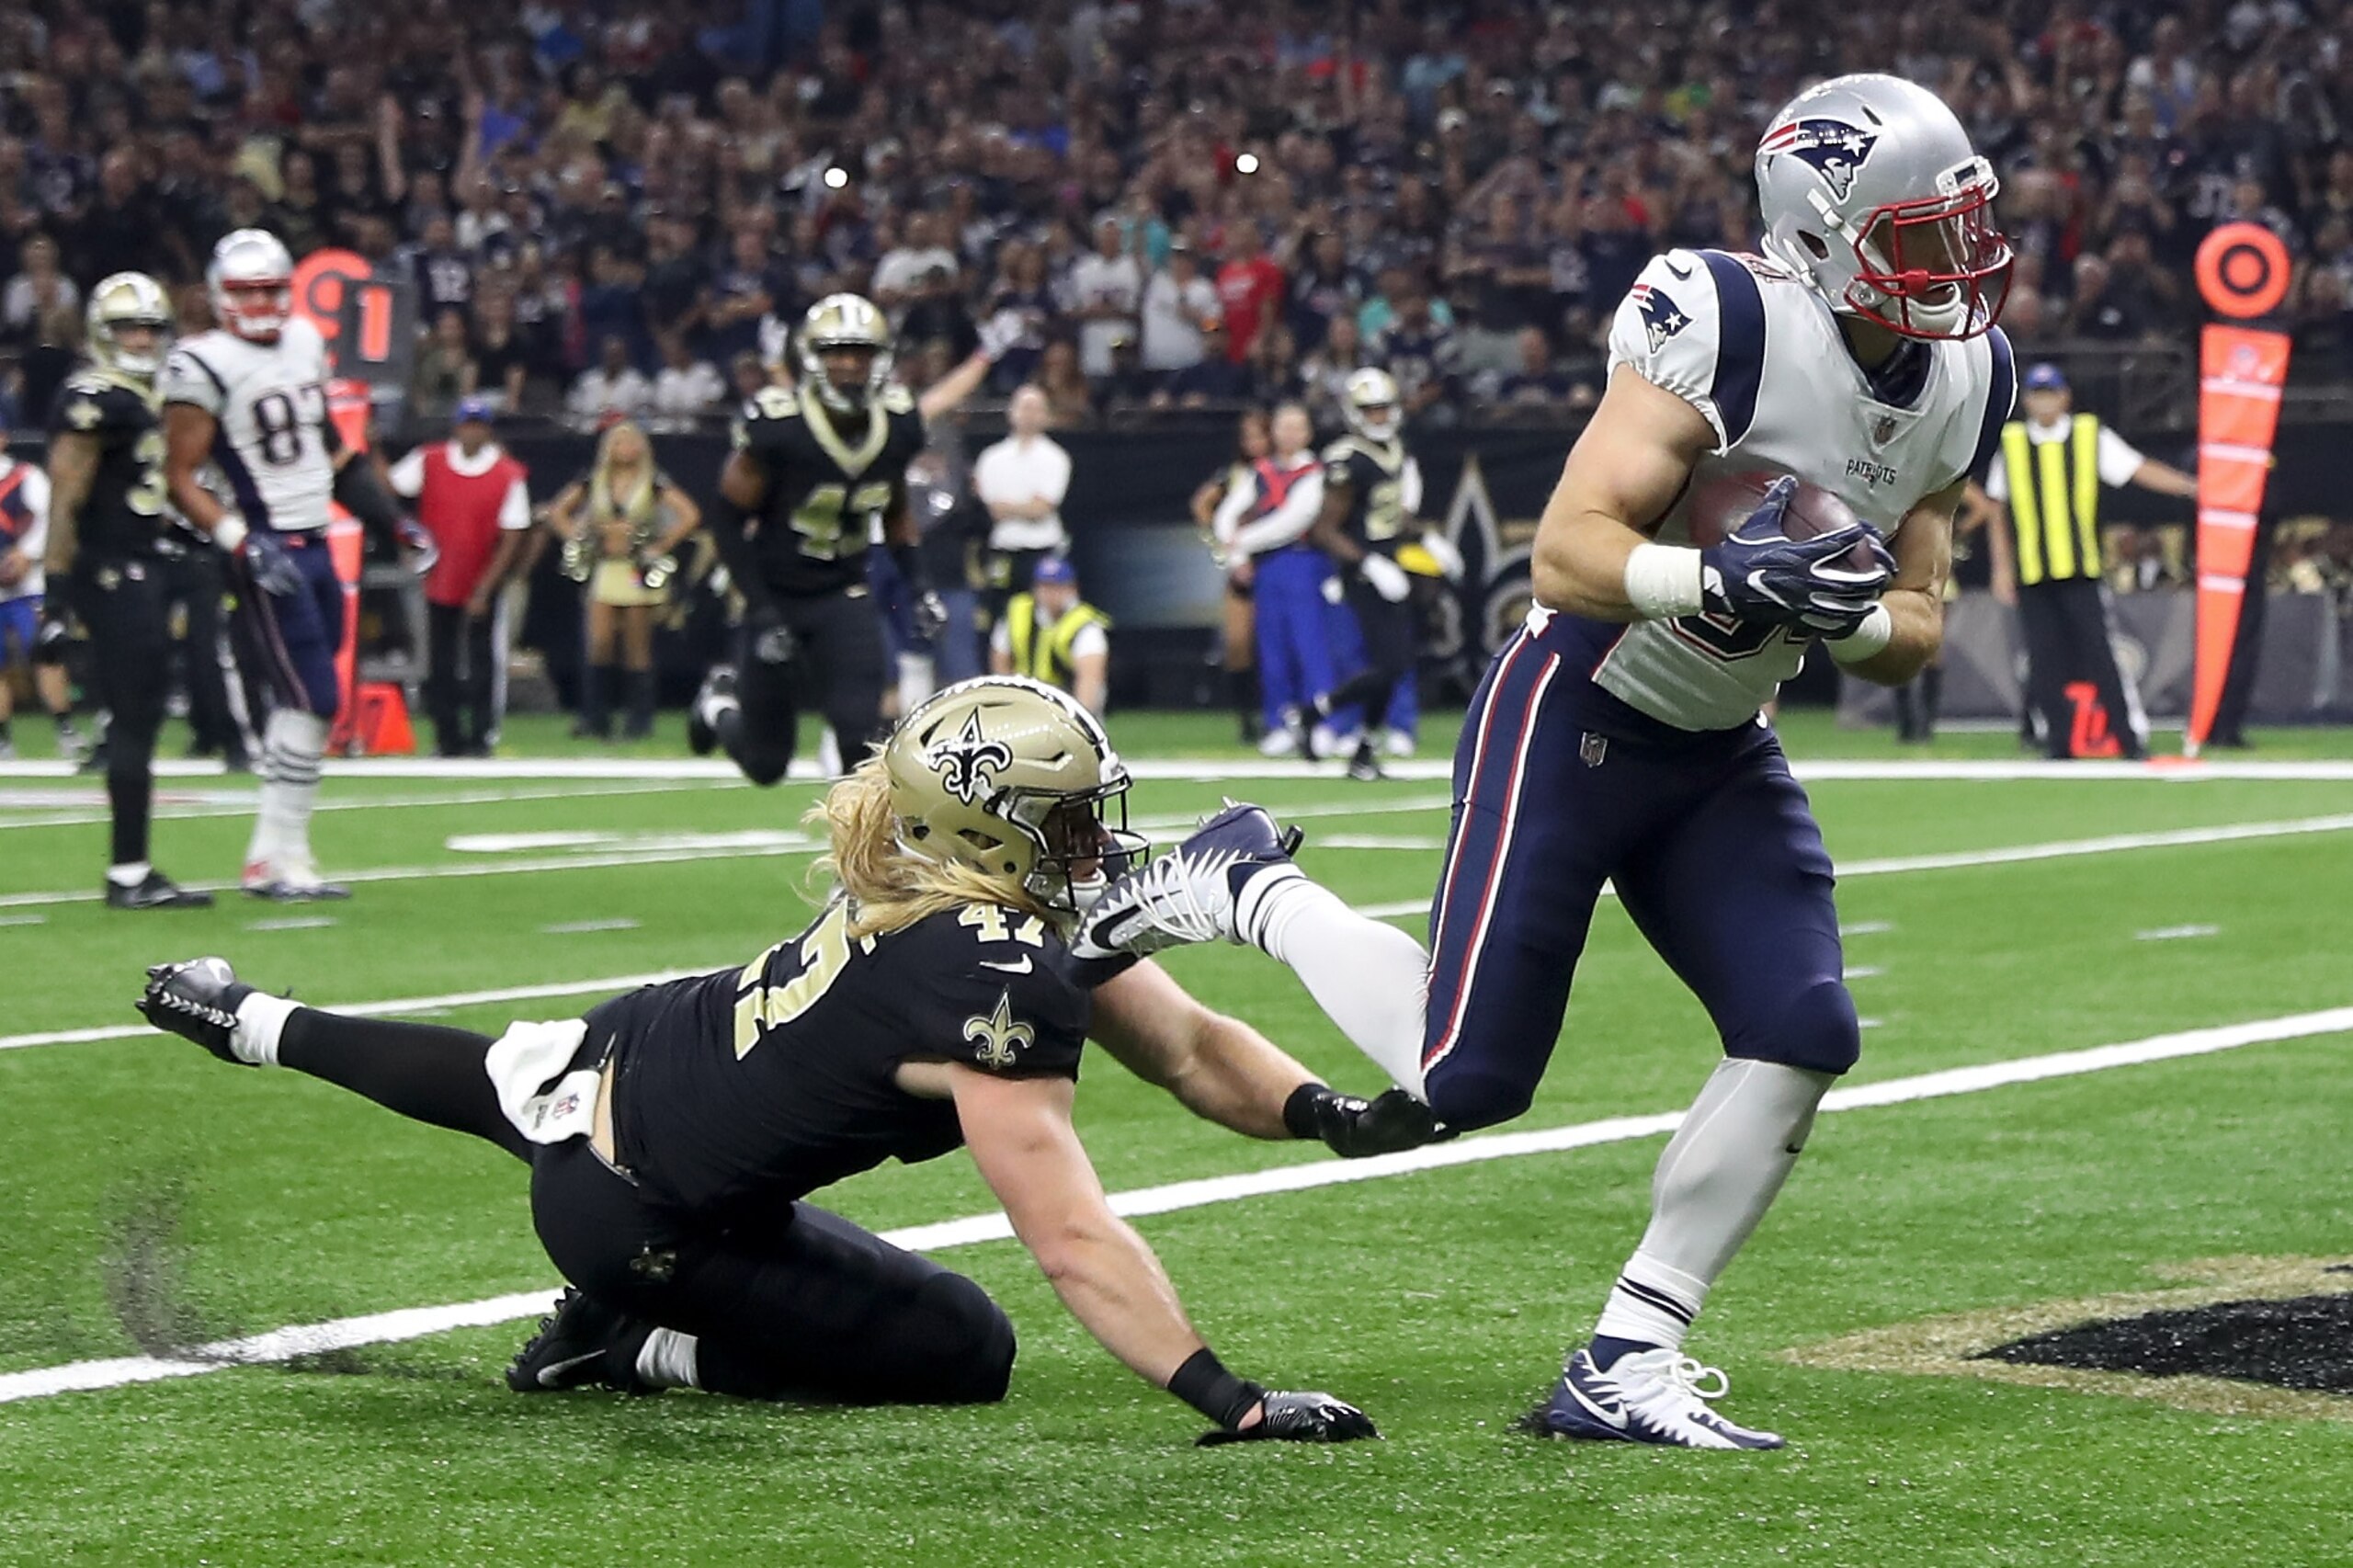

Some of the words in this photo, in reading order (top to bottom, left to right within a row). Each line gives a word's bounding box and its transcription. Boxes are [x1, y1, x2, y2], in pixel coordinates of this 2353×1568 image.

[128, 428, 168, 516] 3
[1846, 460, 1896, 485] PATRIOTS
[958, 903, 1044, 948] 47
